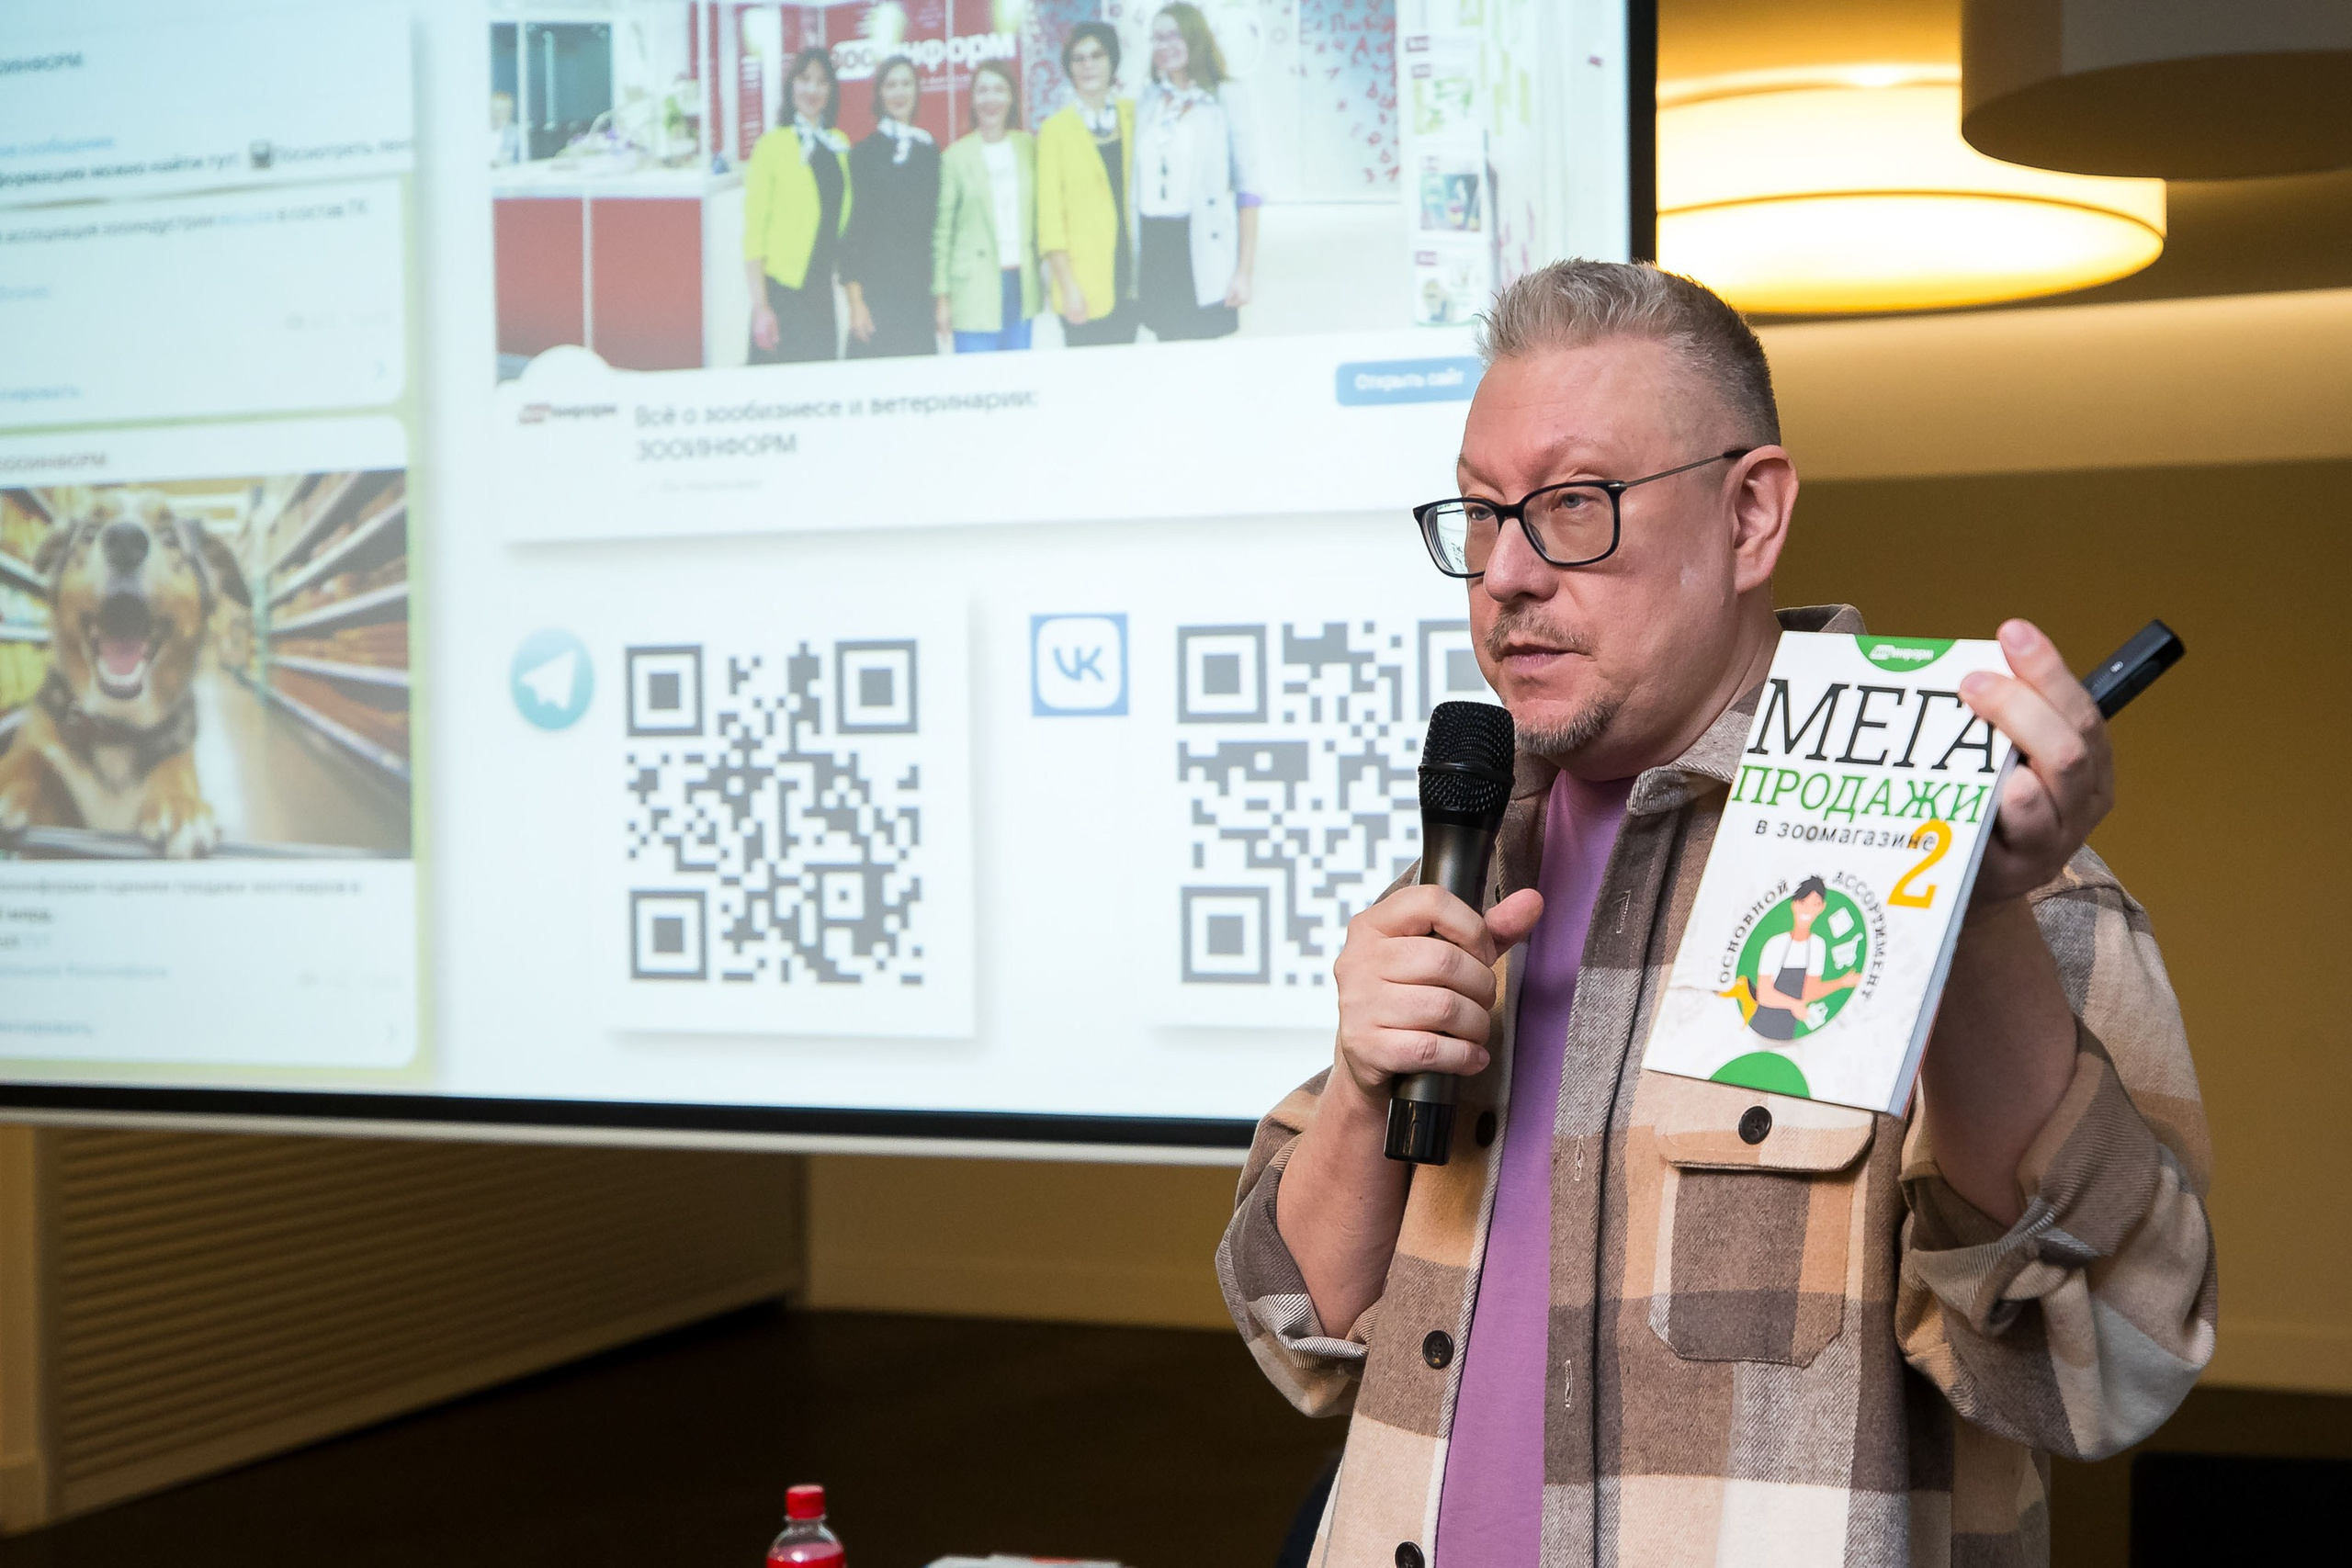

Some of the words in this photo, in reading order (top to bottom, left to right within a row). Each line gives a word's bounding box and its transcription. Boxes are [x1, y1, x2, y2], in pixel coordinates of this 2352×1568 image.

[635, 402, 676, 429] Всё
[684, 405, 696, 425] о
[705, 398, 842, 424] зообизнесе
[849, 400, 863, 416] и
[636, 433, 797, 461] ЗООИНФОРМ
[1747, 678, 1997, 773] МЕГА
[1731, 764, 1993, 823] ПРОДАЖИ
[1755, 819, 1769, 835] в
[1777, 821, 1935, 852] зоомагазине
[1887, 818, 1952, 908] 2
[1719, 877, 1789, 985] ОСНОВНОЙ
[1832, 870, 1888, 1004] АССОРТИМЕНТ
